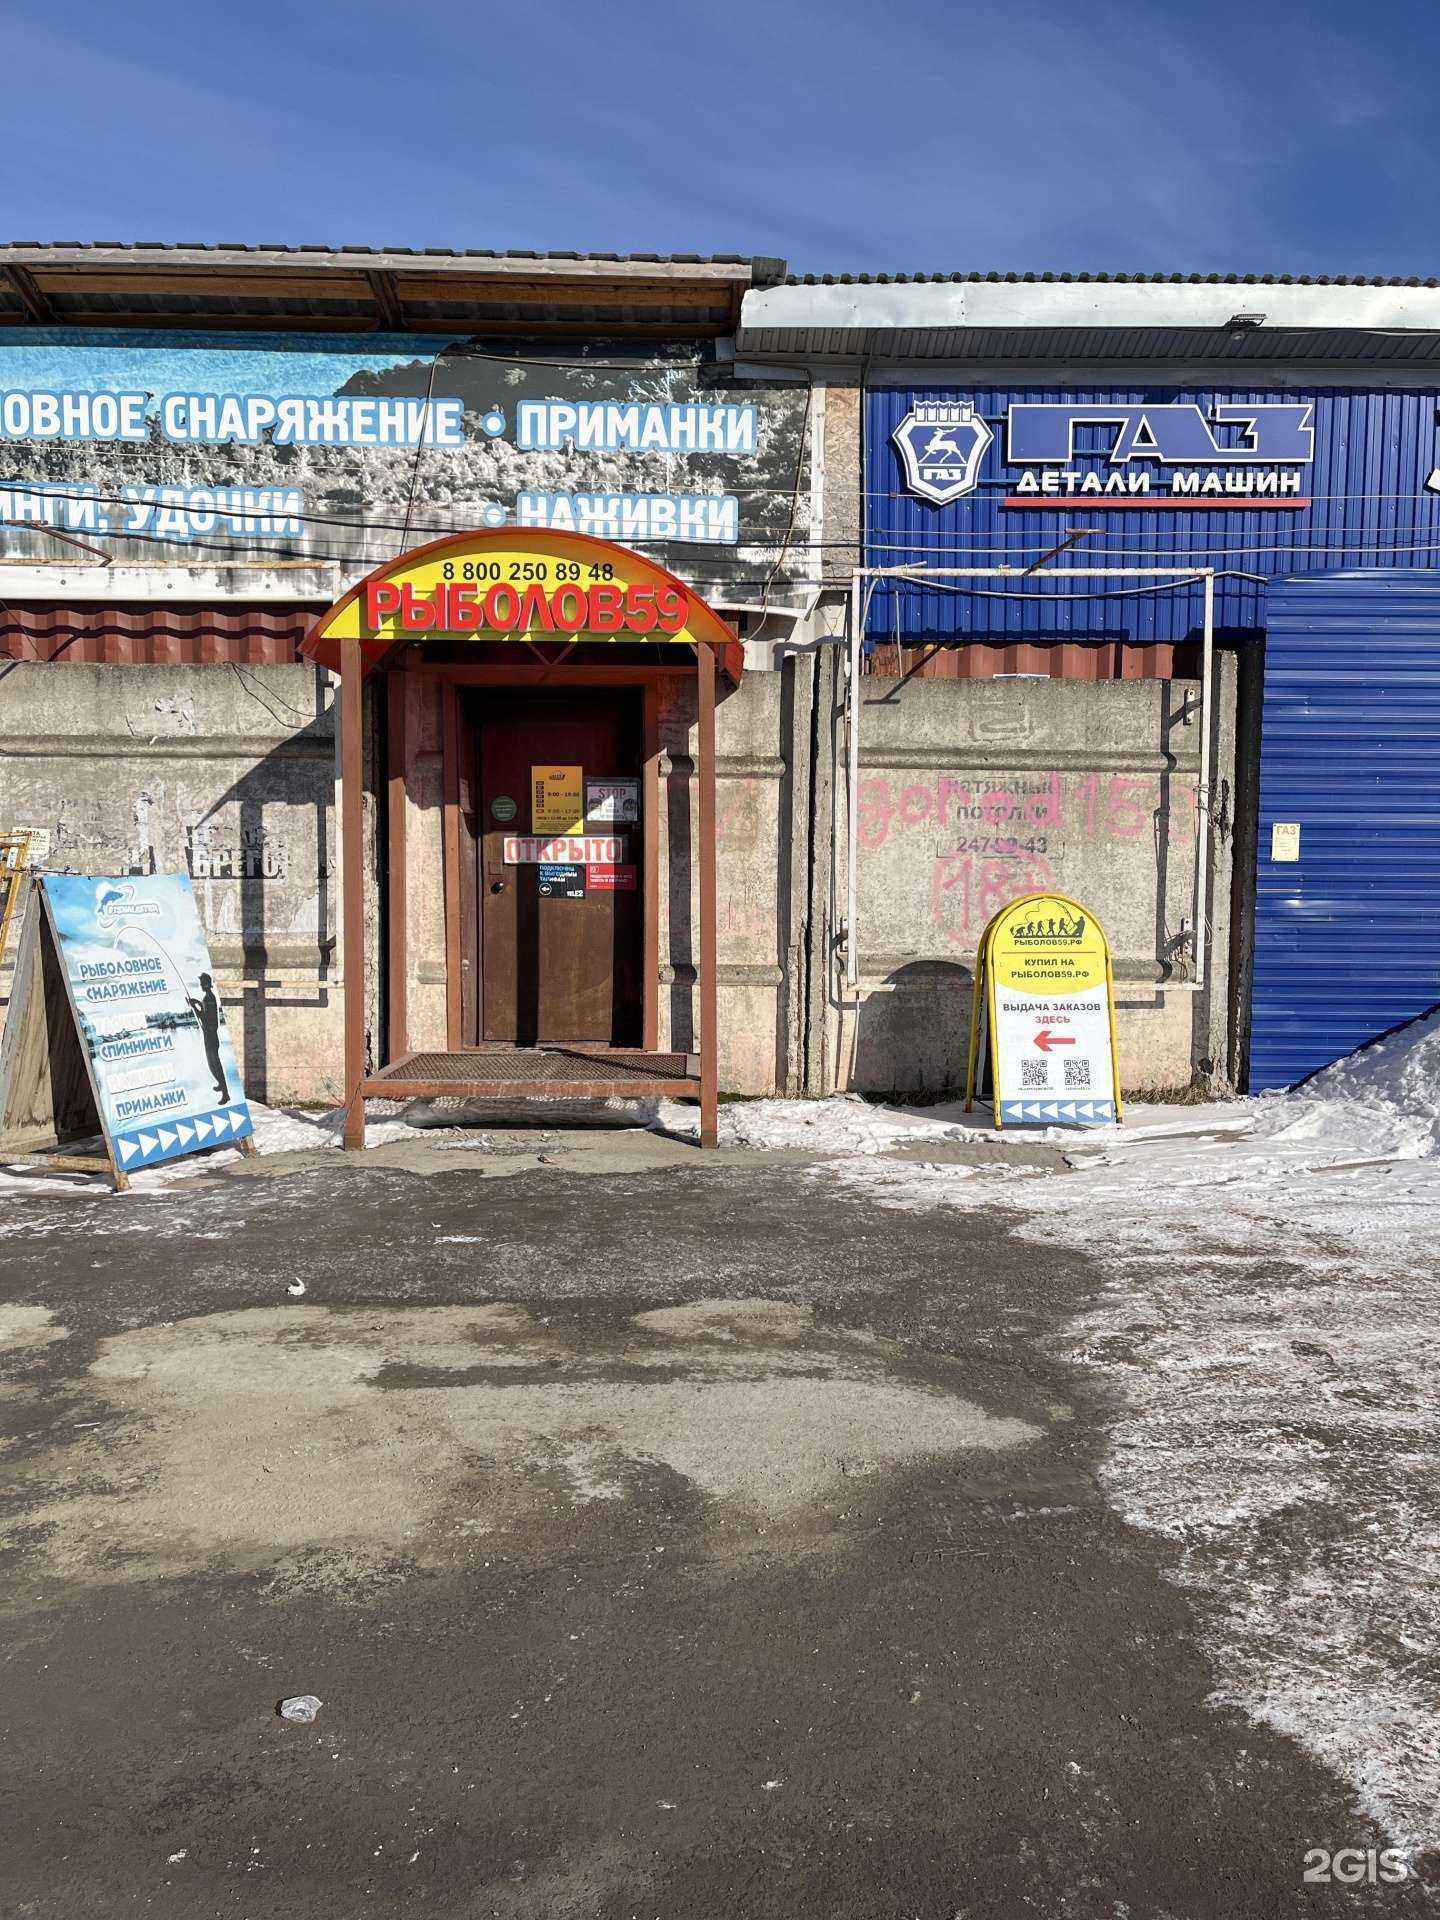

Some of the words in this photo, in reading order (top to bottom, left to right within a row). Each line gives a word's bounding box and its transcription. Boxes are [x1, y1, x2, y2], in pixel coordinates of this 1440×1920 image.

[0, 393, 145, 437] ОВНОЕ
[165, 396, 460, 445] СНАРЯЖЕНИЕ
[521, 403, 753, 450] ПРИМАНКИ
[1008, 404, 1315, 463] ГАЗ
[923, 468, 962, 480] ГАЗ
[1016, 471, 1150, 493] ДЕТАЛИ
[1172, 472, 1301, 492] МАШИН
[126, 488, 301, 536] УДОЧКИ
[520, 496, 734, 541] НАЖИВКИ
[443, 562, 455, 581] 8
[463, 562, 501, 581] 800
[509, 562, 548, 581] 250
[555, 562, 581, 581] 89
[588, 562, 614, 581] 48
[366, 581, 690, 634] РЫБОЛОВ59
[505, 838, 622, 862] ОТКРЫТО
[80, 957, 162, 978] РЫБОЛОВНОЕ
[1024, 958, 1057, 966] КУПИЛ
[86, 979, 168, 1001] СНАРЯЖЕНИЕ
[1003, 1003, 1050, 1012] ВЫДАЧА
[1053, 1003, 1101, 1011] ЗАКАЗОВ
[1034, 1016, 1071, 1024] ЗДЕСЬ
[101, 1034, 173, 1058] СПИННИНГИ
[115, 1089, 187, 1118] ПРИМАНКИ
